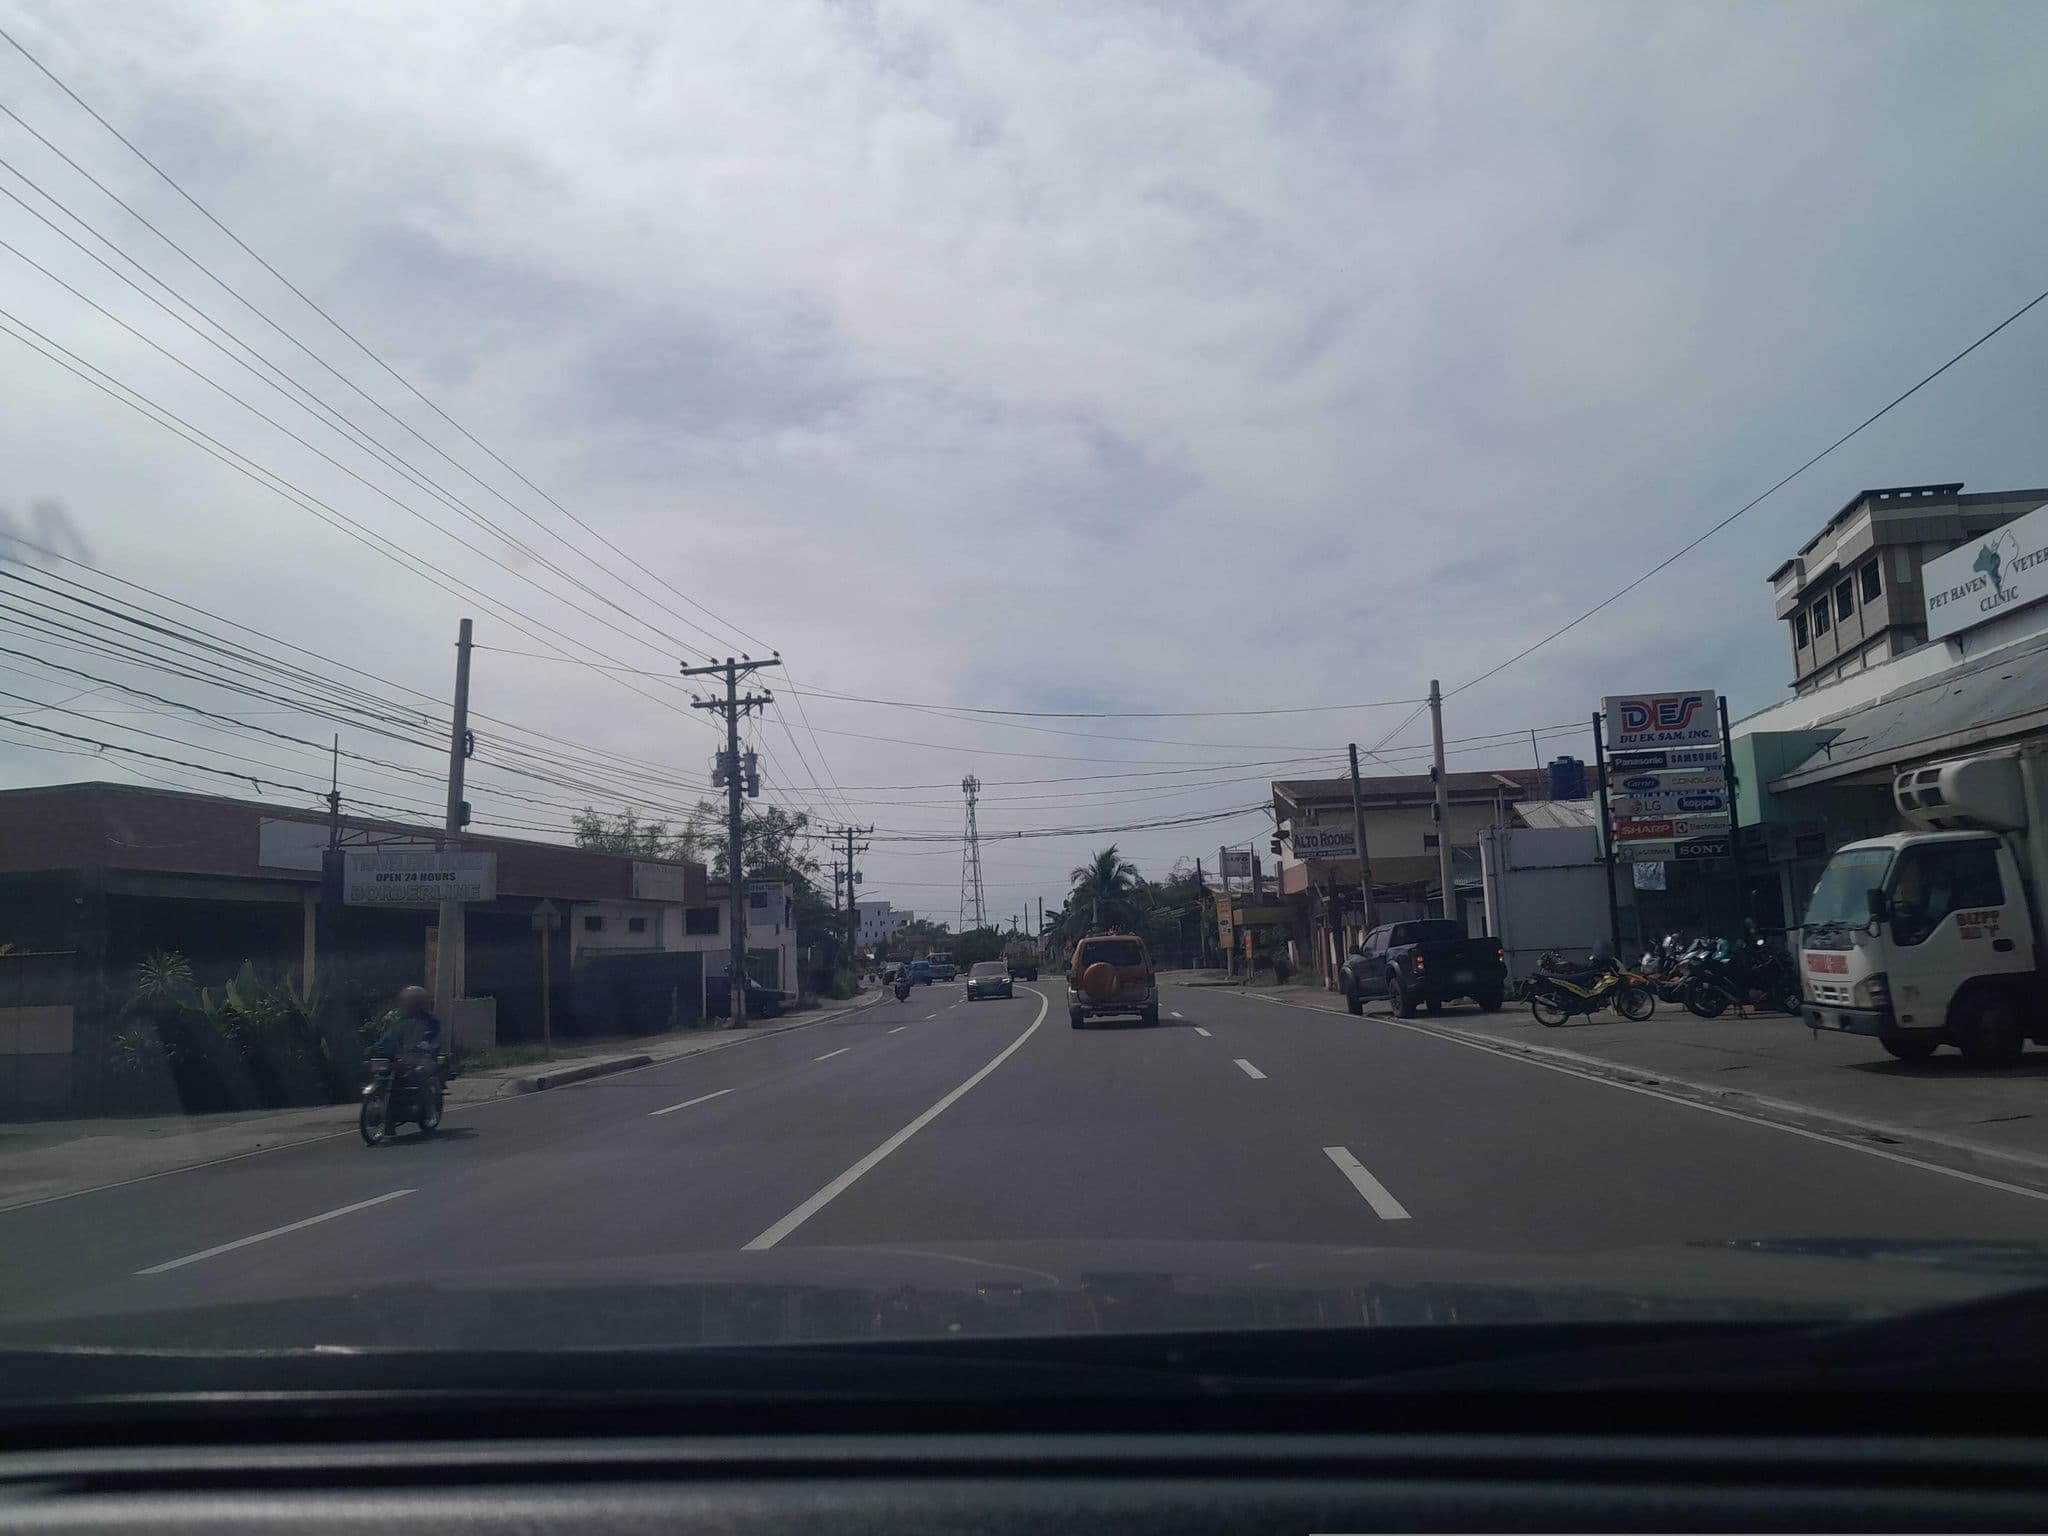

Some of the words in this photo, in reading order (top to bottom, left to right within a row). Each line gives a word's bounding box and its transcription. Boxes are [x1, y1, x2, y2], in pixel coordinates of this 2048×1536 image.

[1929, 592, 1948, 610] PET
[1950, 574, 1988, 602] HAVEN
[1980, 585, 2019, 612] CLINIC
[1620, 696, 1702, 733] DES
[1619, 734, 1637, 744] DU
[1639, 733, 1656, 743] EK
[1615, 755, 1664, 767] Panasonic
[1671, 752, 1718, 764] SAMSUNG
[1644, 800, 1662, 812] LG
[1621, 823, 1670, 836] SHARP
[1294, 833, 1318, 849] ALTO
[1320, 832, 1354, 847] ROOMS
[1680, 843, 1725, 856] SONY
[376, 872, 401, 882] OPEN
[404, 872, 417, 882] 24
[420, 872, 456, 882] HOURS
[351, 883, 481, 900] BORDERLINE
